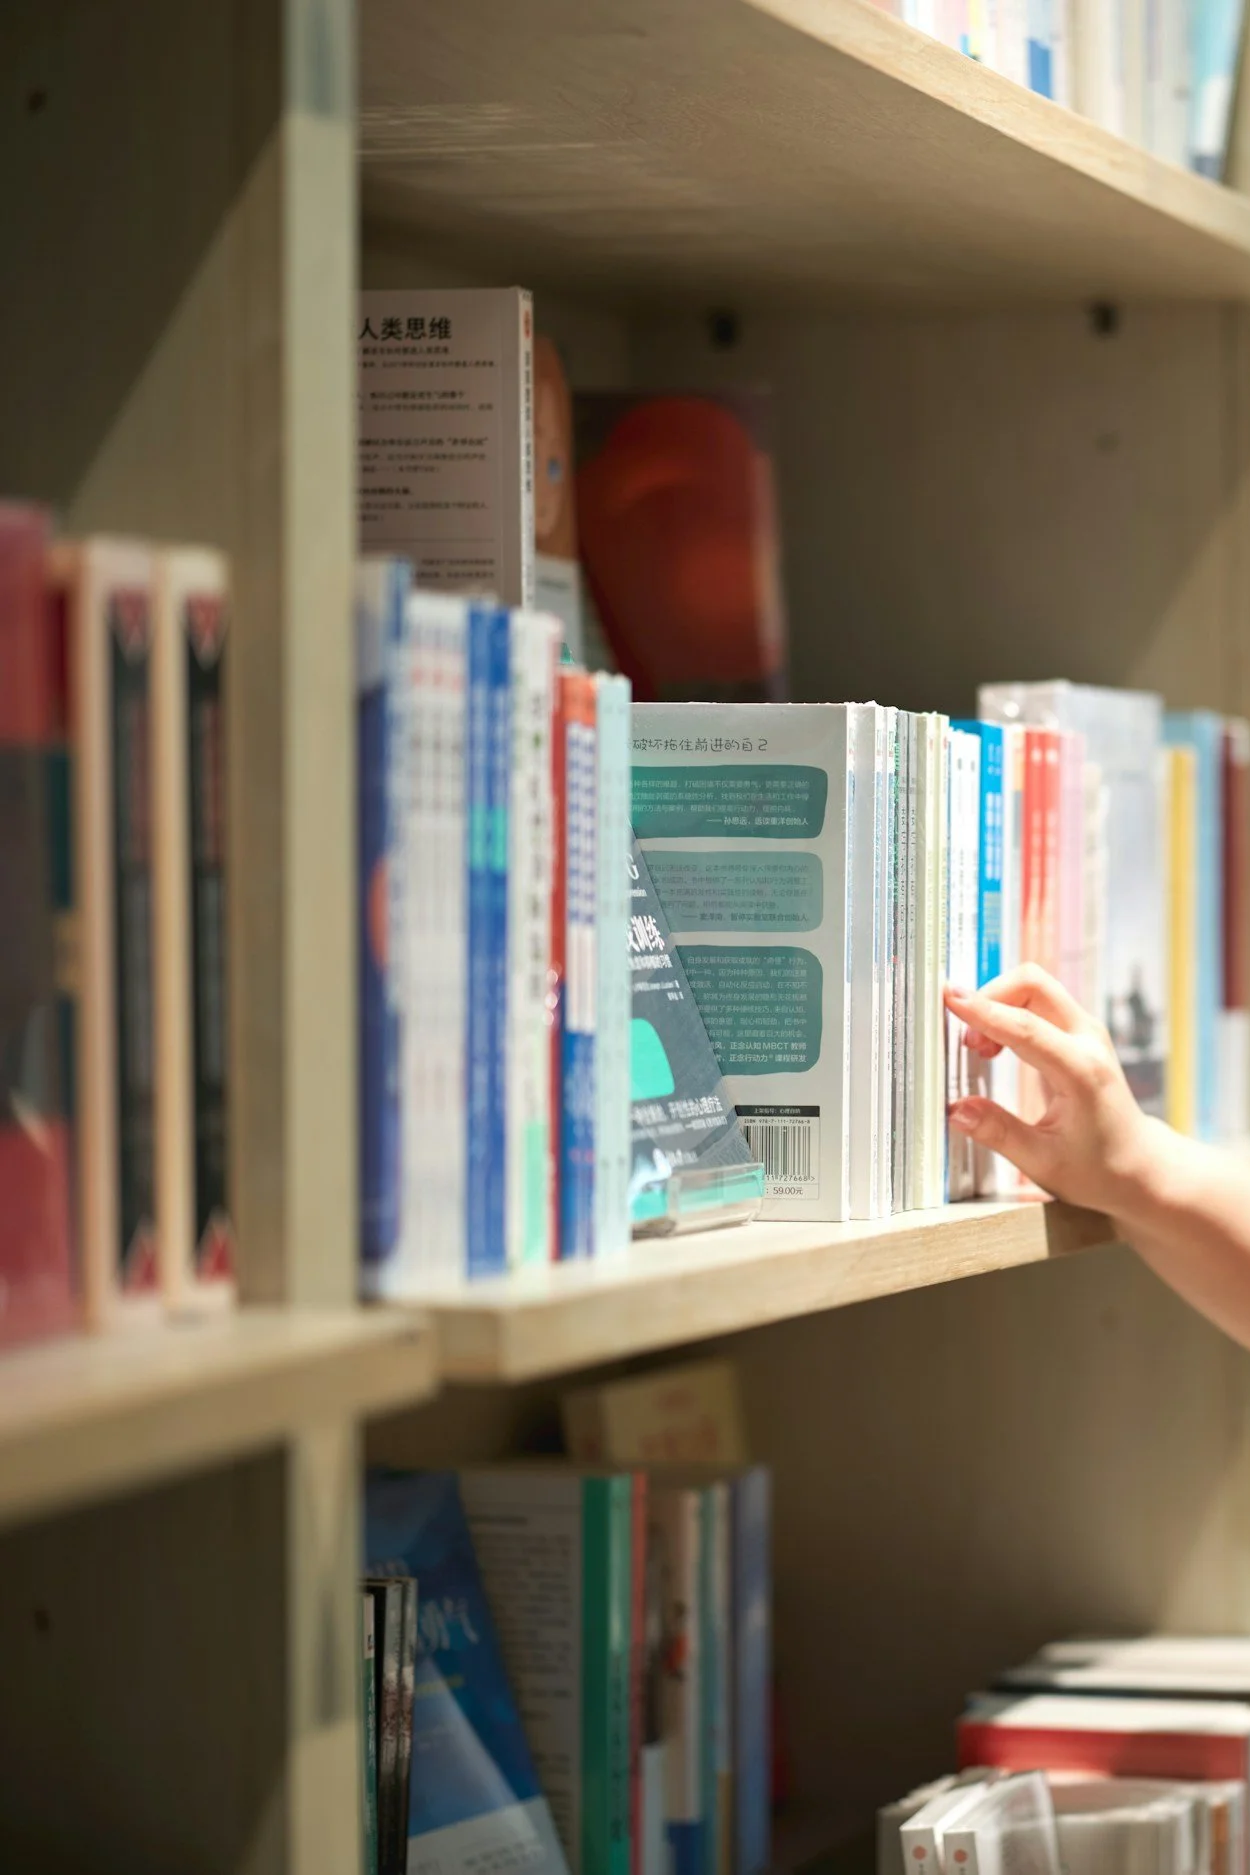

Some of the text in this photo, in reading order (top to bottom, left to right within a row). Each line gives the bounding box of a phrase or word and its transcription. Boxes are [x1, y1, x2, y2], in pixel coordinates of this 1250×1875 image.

[359, 317, 452, 341] 人类思维
[762, 1041, 789, 1050] MBCT
[790, 1041, 807, 1050] 教师
